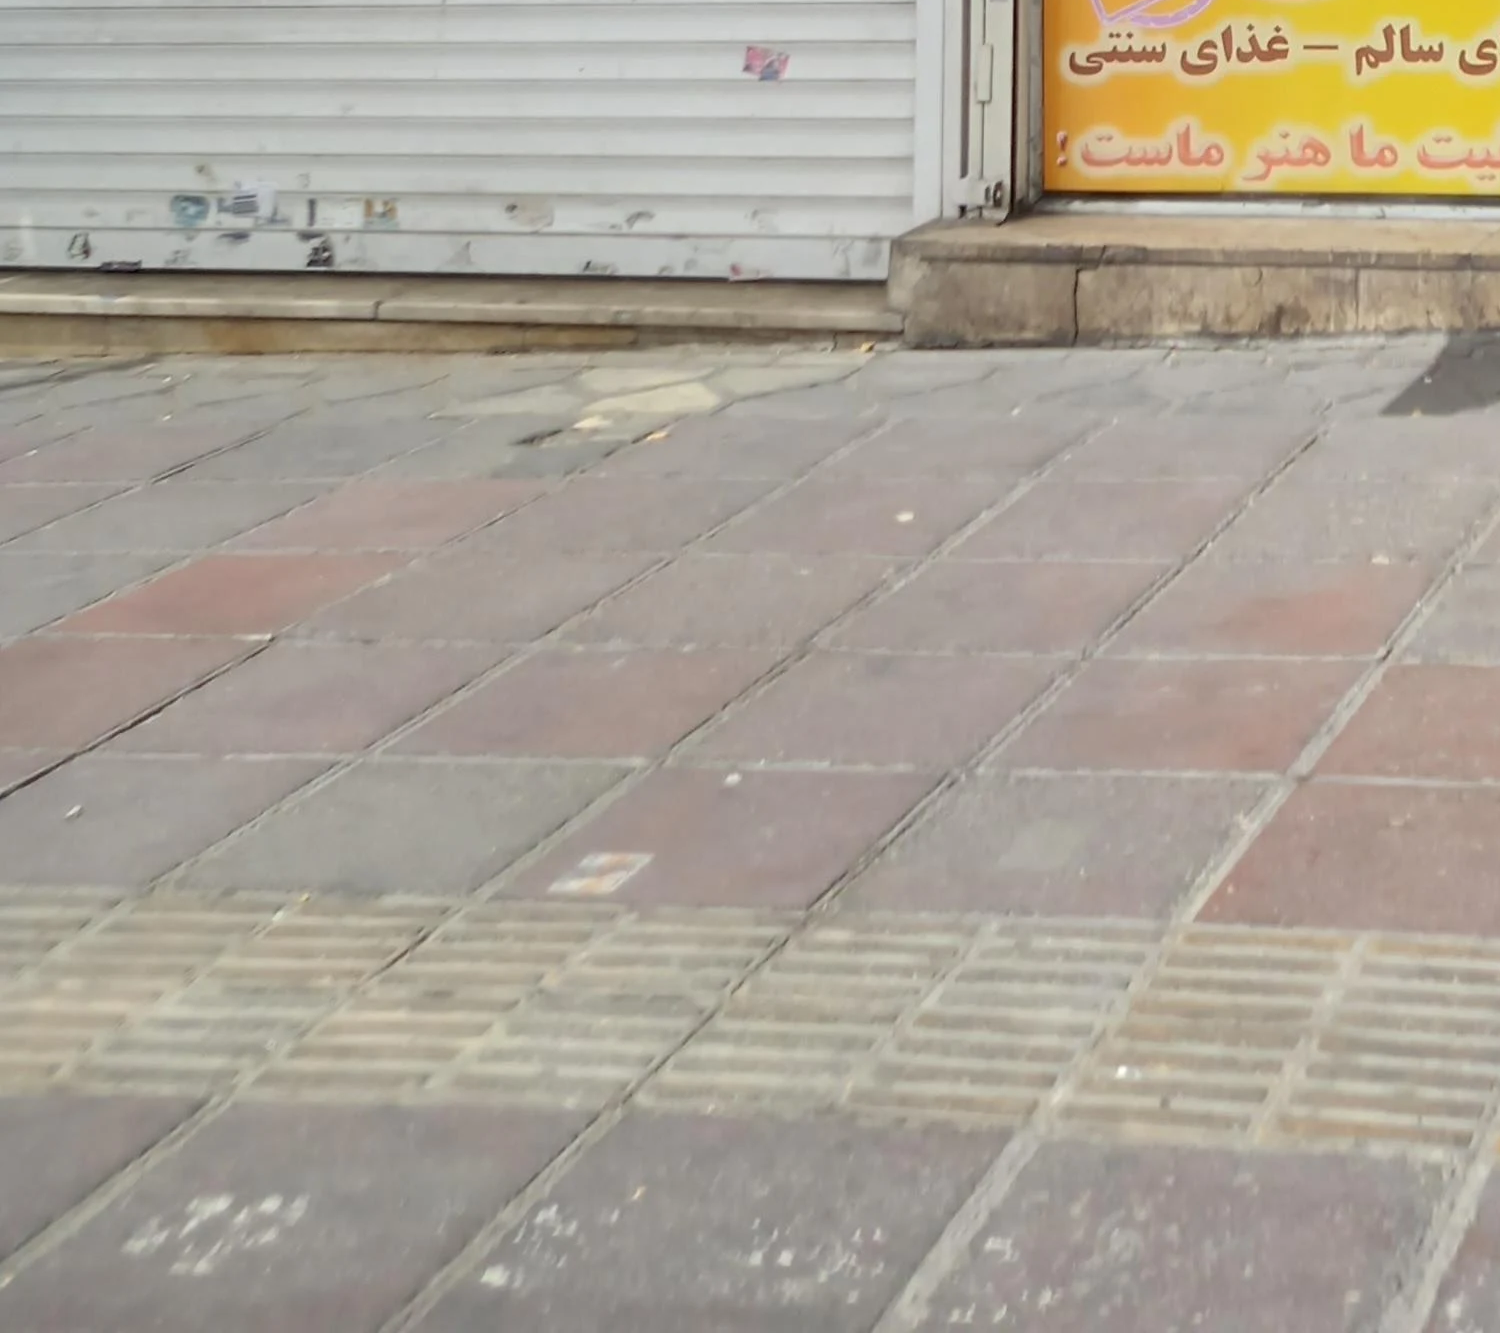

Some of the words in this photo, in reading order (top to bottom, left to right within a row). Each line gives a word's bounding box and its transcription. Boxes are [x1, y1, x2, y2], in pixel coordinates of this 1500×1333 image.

[1067, 29, 1168, 76] سنتی
[1179, 23, 1291, 76] غذای
[1353, 23, 1446, 77] سالم
[1241, 129, 1333, 182] هنر
[1348, 124, 1400, 170] ما
